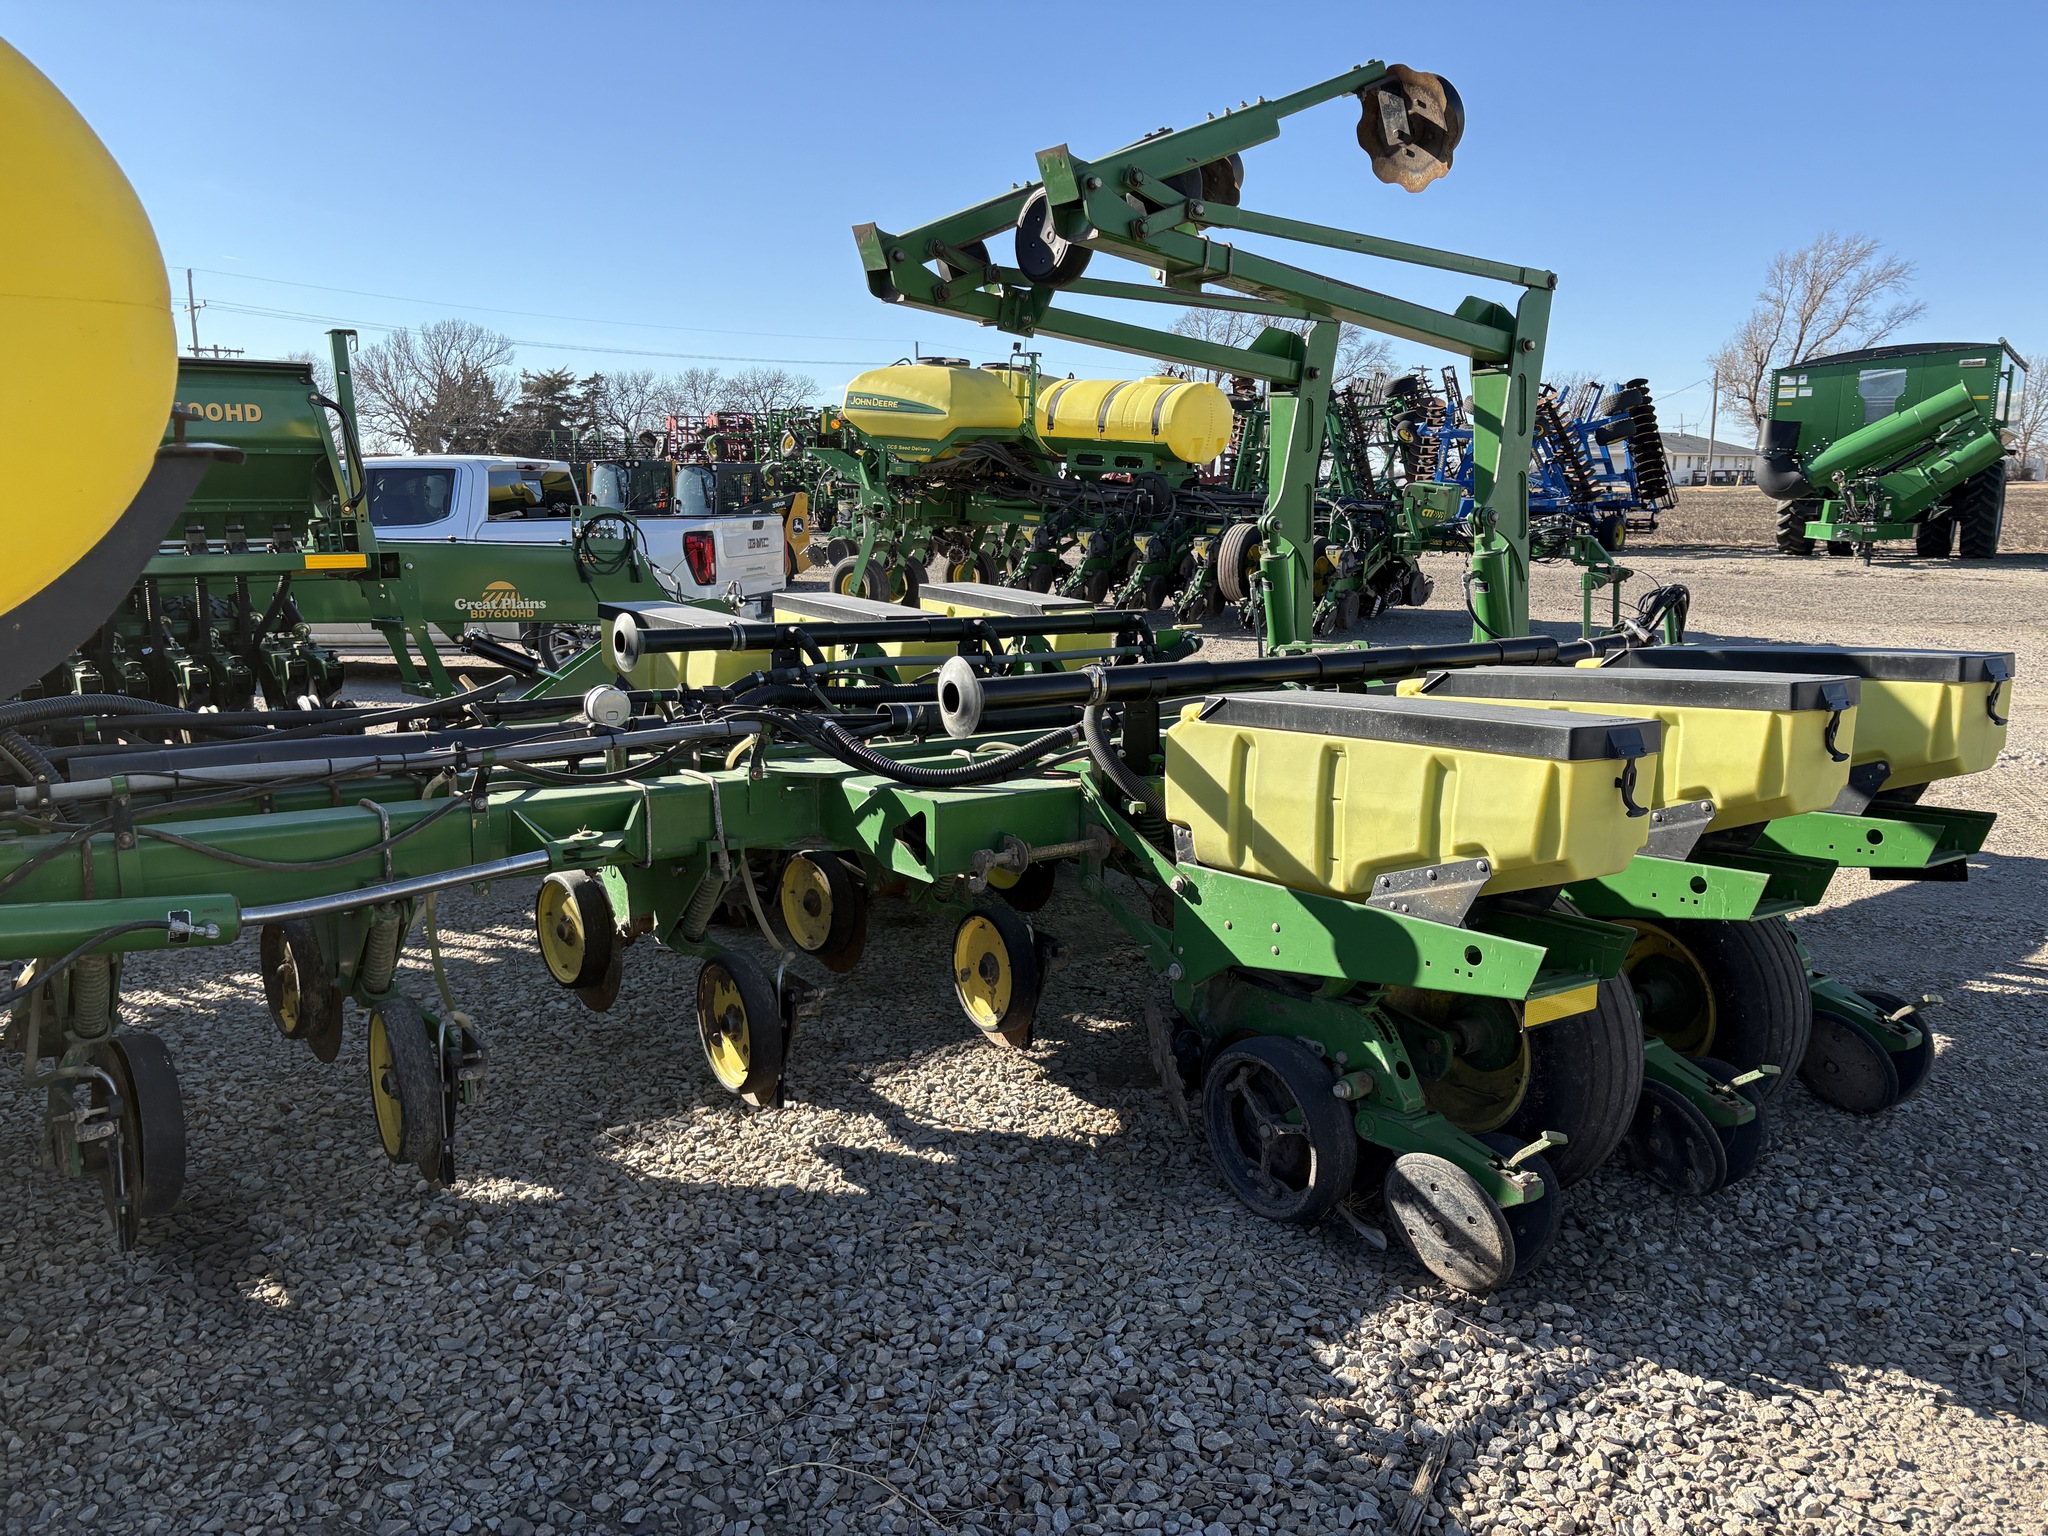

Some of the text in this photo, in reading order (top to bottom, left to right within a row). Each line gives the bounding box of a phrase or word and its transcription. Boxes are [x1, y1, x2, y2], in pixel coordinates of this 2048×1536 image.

[850, 396, 899, 408] JOHN DEERE
[175, 402, 262, 422] 00HD
[911, 445, 931, 453] Delivery
[747, 537, 769, 549] GMC
[454, 597, 547, 610] Great Plains
[470, 609, 535, 619] BD7600HD
